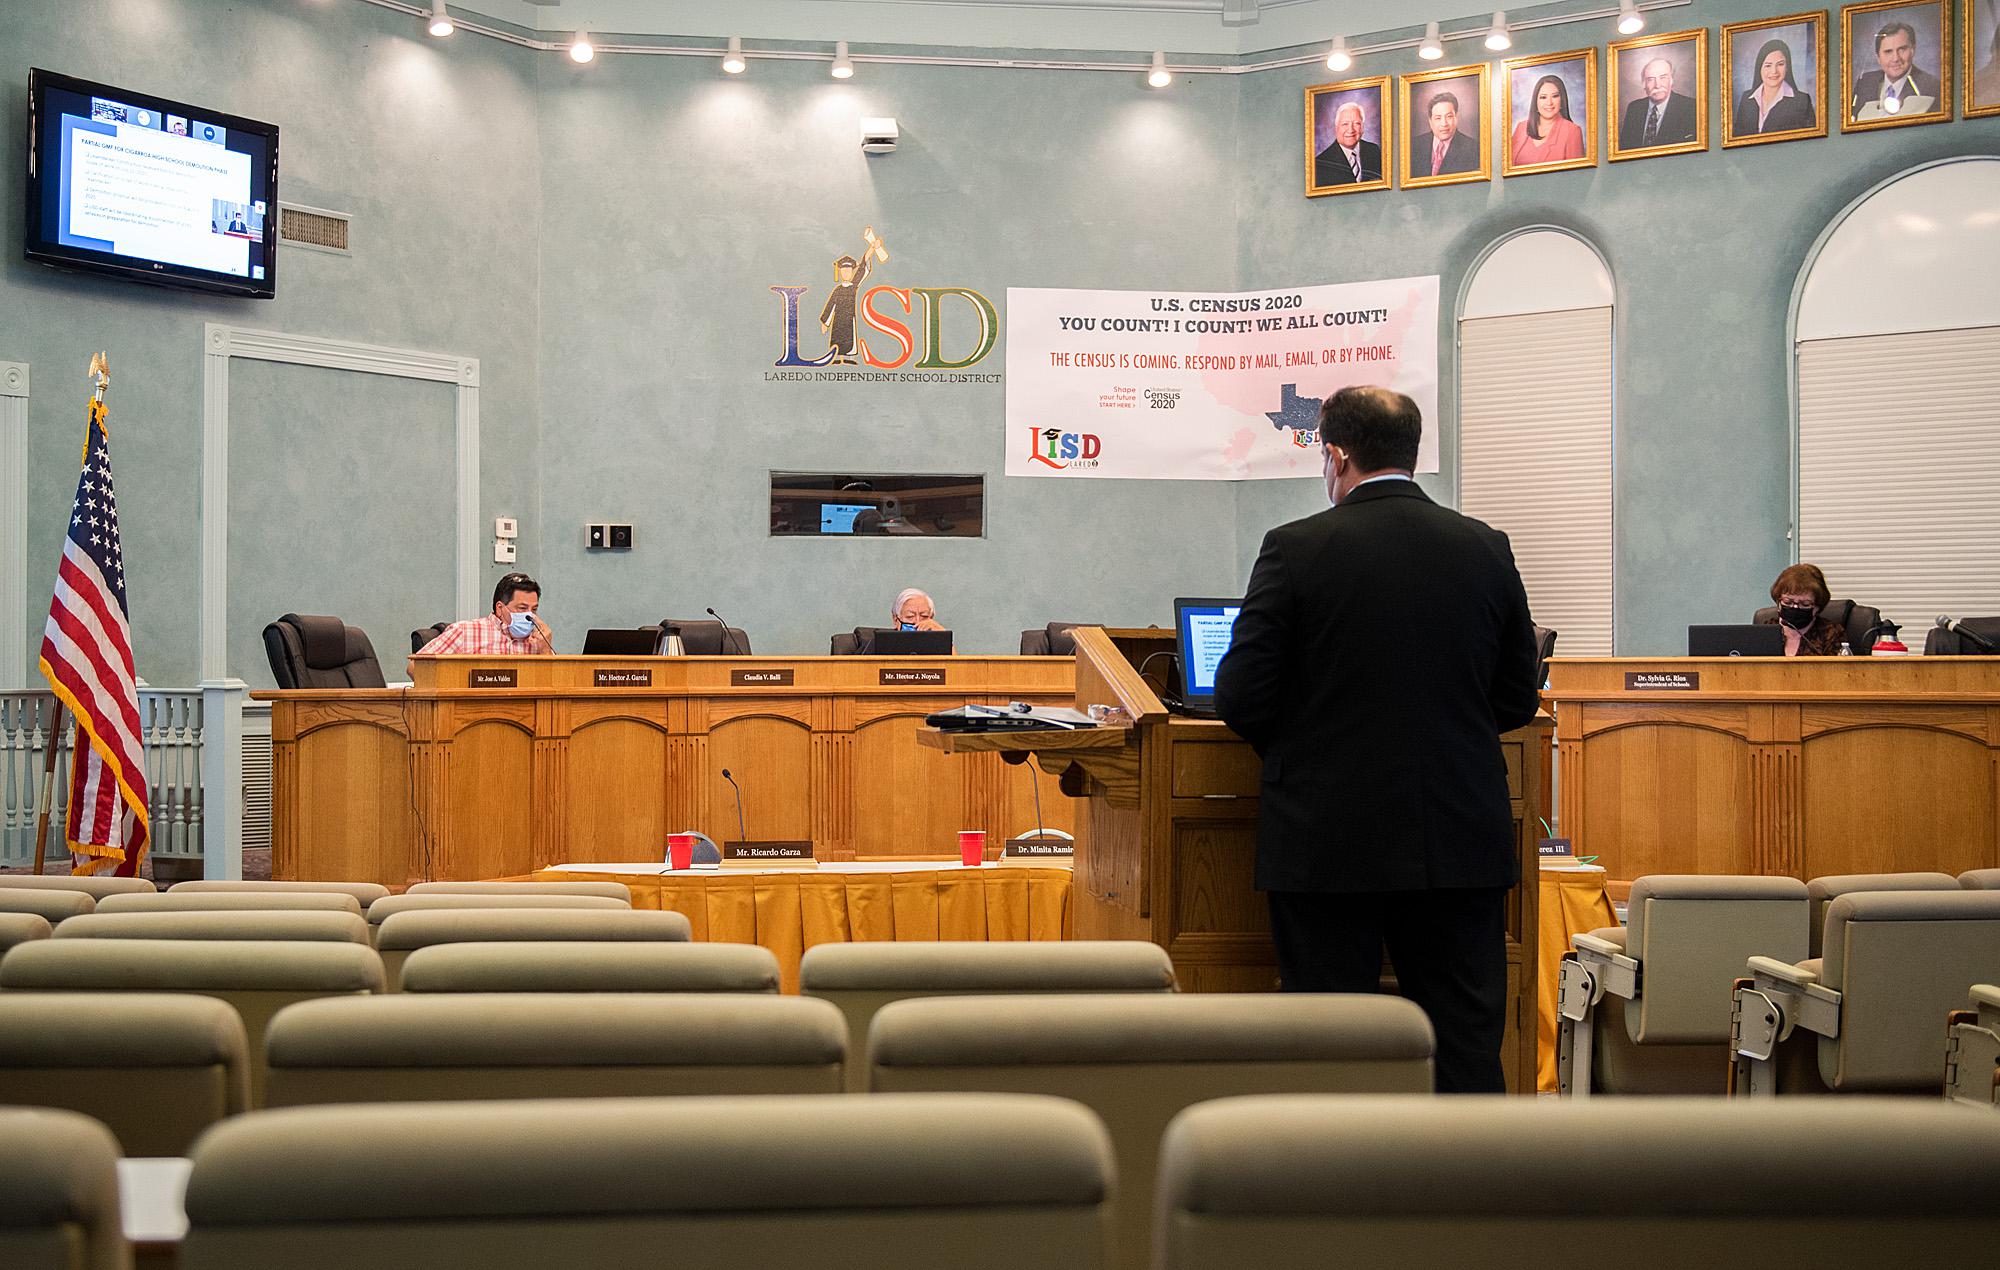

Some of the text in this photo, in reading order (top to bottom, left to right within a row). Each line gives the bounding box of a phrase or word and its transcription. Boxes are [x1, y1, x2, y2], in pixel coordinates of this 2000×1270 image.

[1151, 295, 1303, 313] U.S. CENSUS 2020
[1059, 309, 1388, 334] YOU COUNT! I COUNT! WE ALL COUNT!
[1050, 345, 1396, 370] THE CENSUS IS COMING. RESPOND BY MAIL, EMAIL, OR BY PHONE.
[764, 372, 1002, 383] LAREDO INDEPENDENT SCHOOL DISTRICT
[1144, 389, 1181, 400] Census
[1150, 399, 1175, 409] 2020
[921, 673, 940, 681] Noyola
[1648, 674, 1665, 682] Sylvia
[751, 848, 779, 856] Ricardo
[1030, 845, 1052, 853] Minita
[1555, 845, 1565, 853] III
